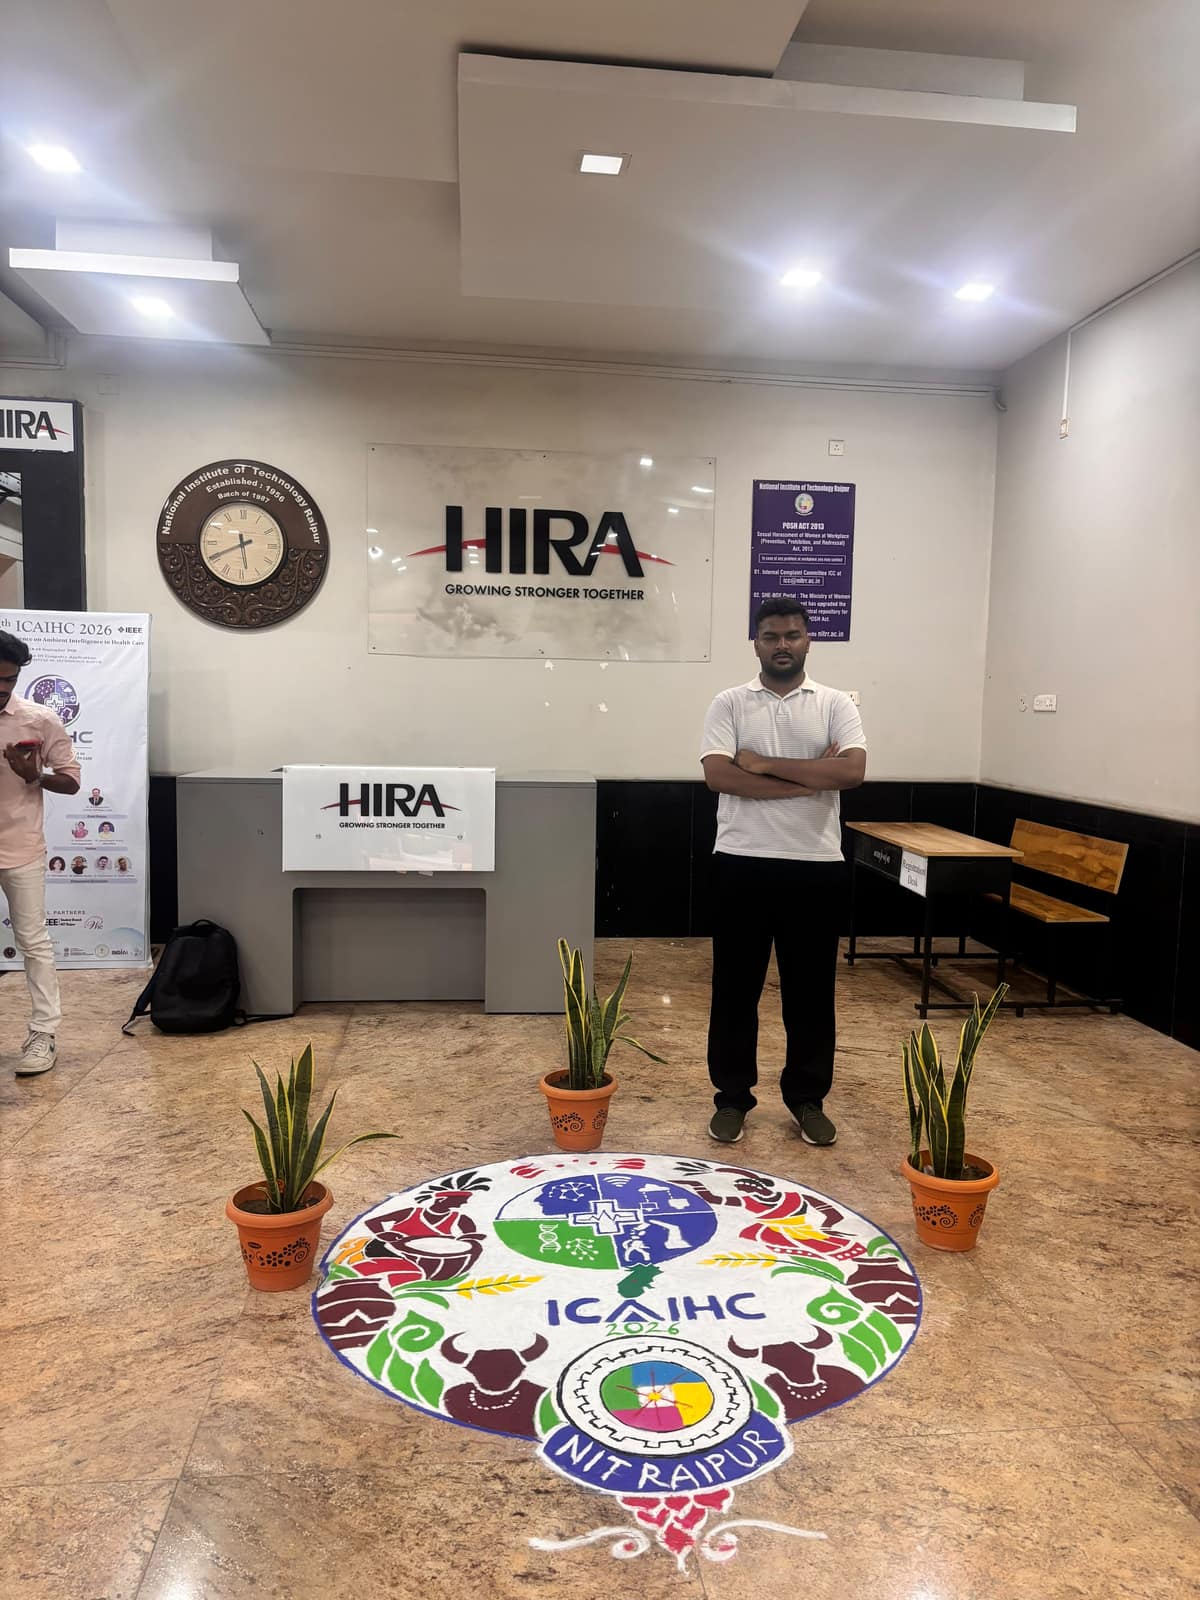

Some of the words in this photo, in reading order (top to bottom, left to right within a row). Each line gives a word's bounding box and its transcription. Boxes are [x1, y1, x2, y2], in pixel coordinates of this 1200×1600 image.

[206, 478, 258, 494] Established
[265, 485, 285, 503] 1956
[217, 491, 239, 500] Batch
[760, 483, 779, 491] National
[807, 485, 833, 493] Technology
[161, 490, 187, 536] National
[186, 468, 229, 493] Institute
[235, 466, 245, 474] of
[252, 467, 308, 507] Technology
[303, 508, 321, 545] Raipur
[783, 522, 797, 530] POSH
[811, 523, 824, 531] 2013
[445, 505, 645, 578] HIRA
[445, 584, 511, 597] GROWING
[514, 586, 580, 599] STRONGER
[583, 588, 645, 601] TOGETHER
[0, 618, 11, 629] th
[16, 620, 75, 635] ICAIHC
[80, 624, 113, 636] 2026
[339, 783, 446, 817] HIRA
[547, 1292, 767, 1326] ICAIHC
[606, 1321, 681, 1337] 2026
[555, 1433, 633, 1481] NIT
[638, 1430, 779, 1491] RAIPUR
